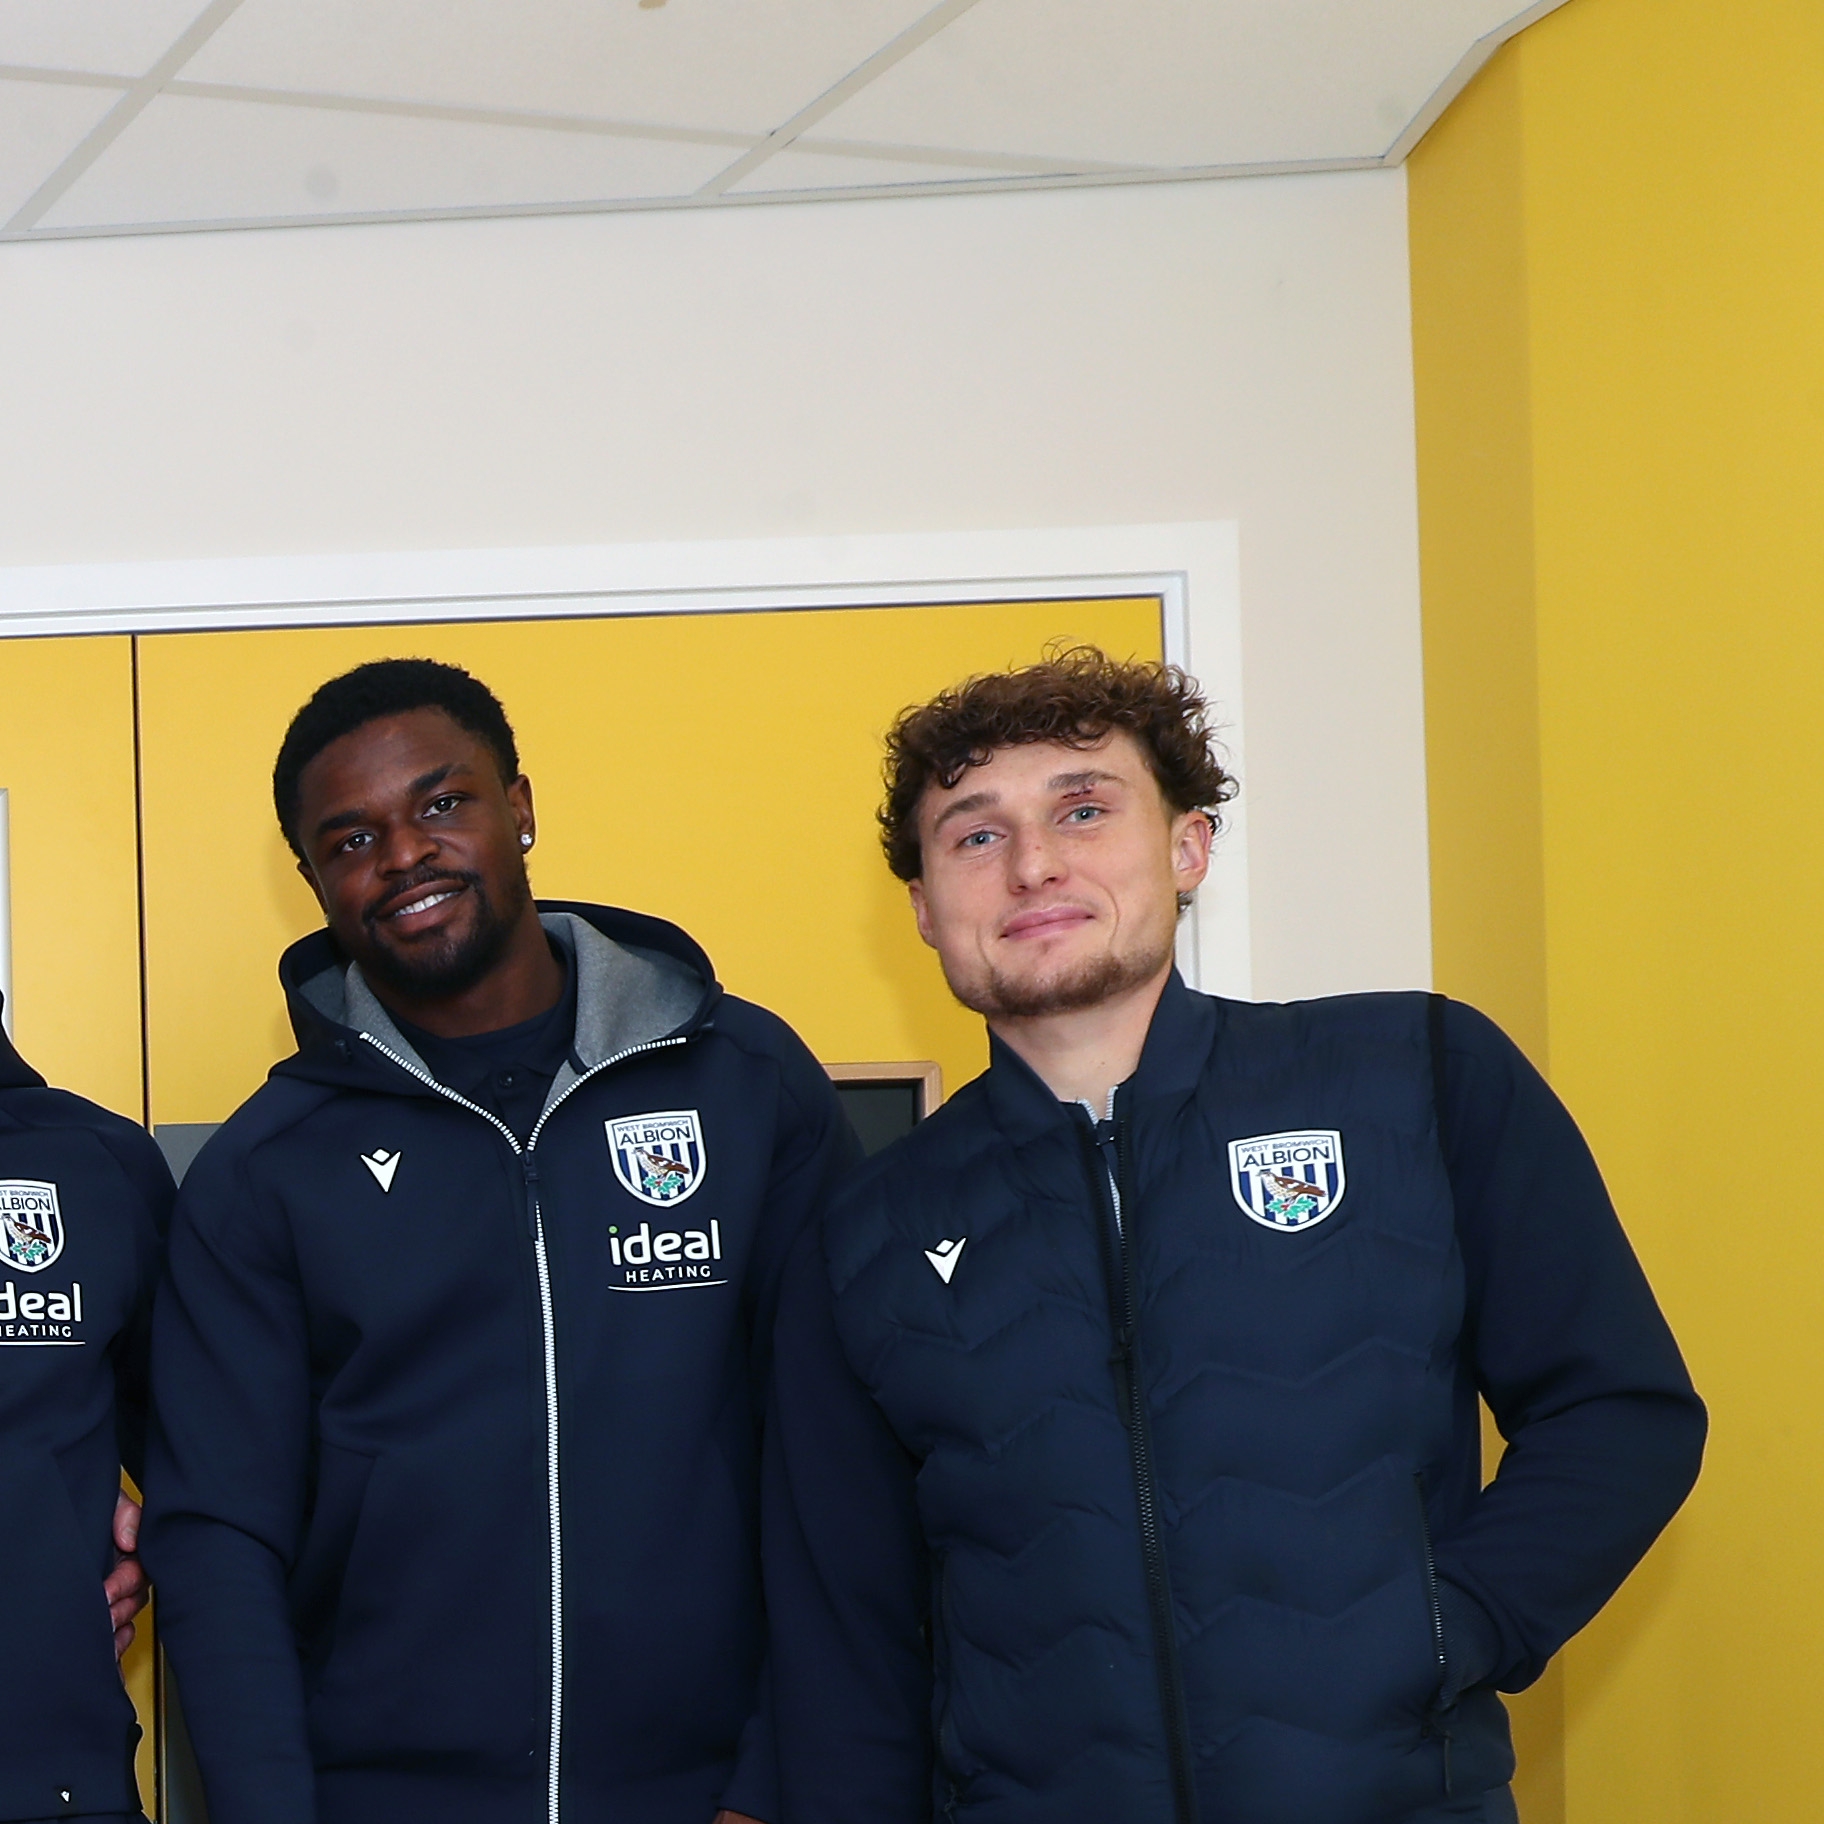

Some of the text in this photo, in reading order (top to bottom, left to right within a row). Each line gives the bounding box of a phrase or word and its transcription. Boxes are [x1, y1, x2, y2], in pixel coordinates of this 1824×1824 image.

[620, 1126, 691, 1146] ALBION
[1242, 1145, 1330, 1169] ALBION
[608, 1219, 721, 1266] ideal
[625, 1265, 711, 1283] HEATING
